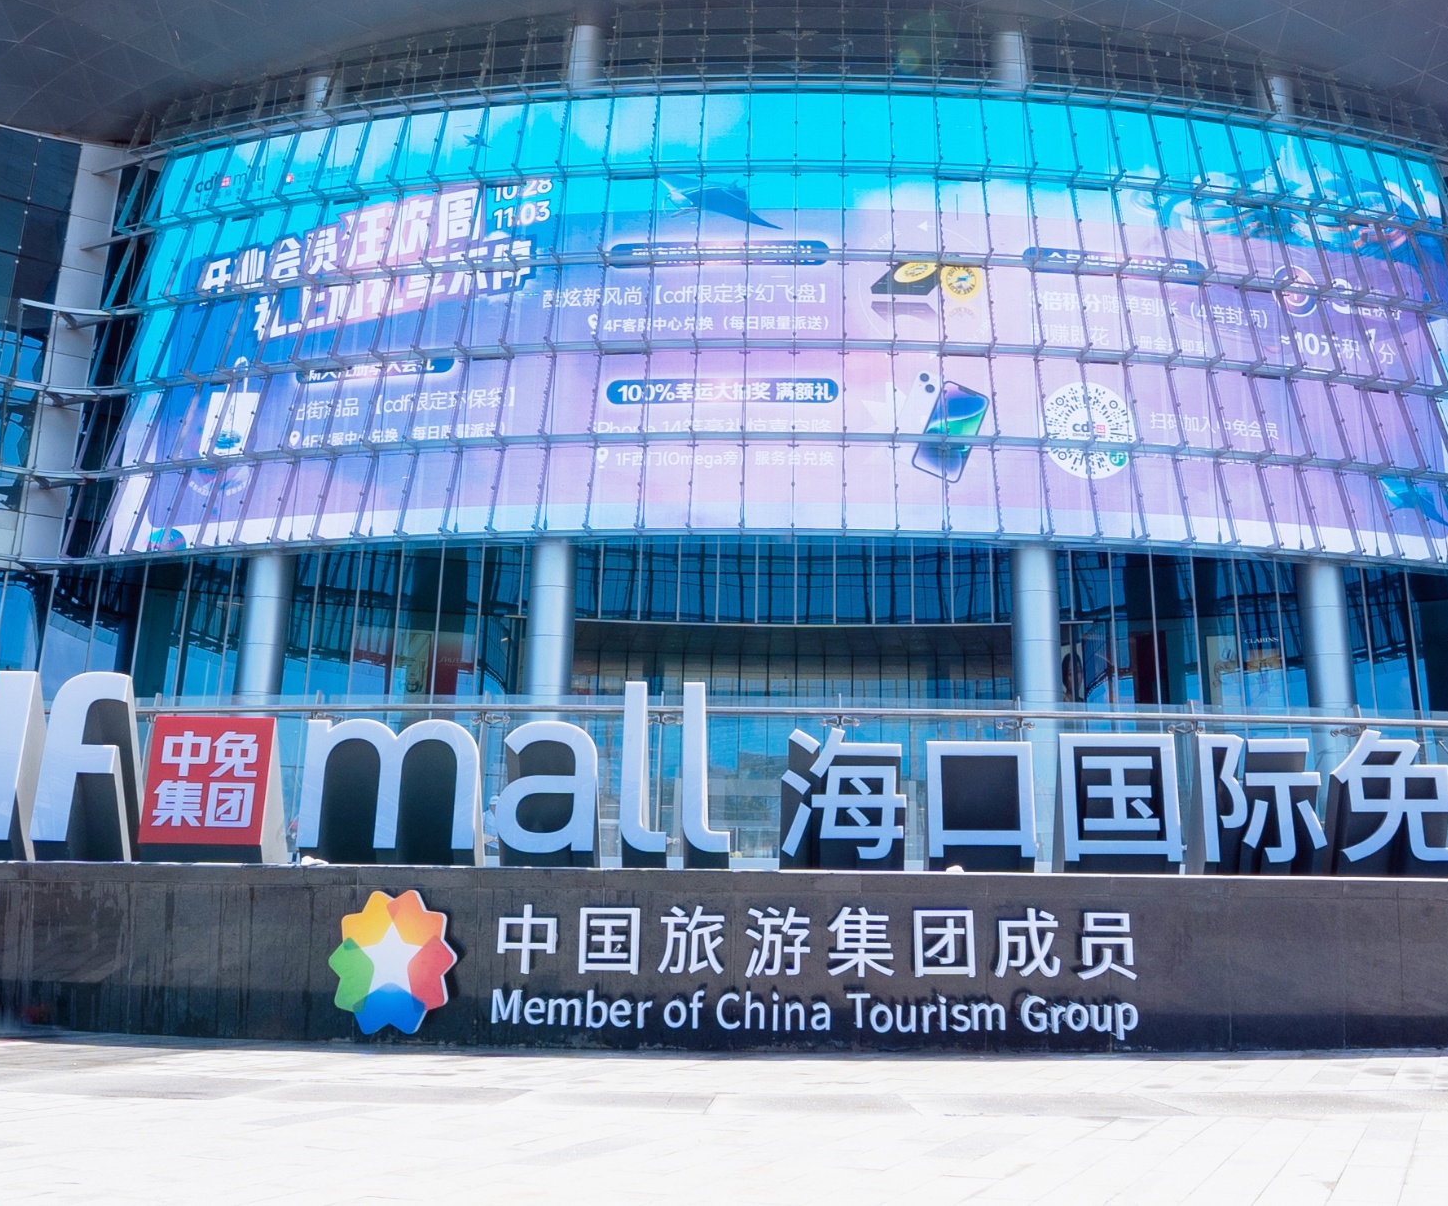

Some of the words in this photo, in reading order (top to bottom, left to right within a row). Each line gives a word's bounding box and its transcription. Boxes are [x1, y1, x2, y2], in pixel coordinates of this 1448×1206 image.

[493, 200, 551, 230] 11.03
[1244, 636, 1279, 644] CLARINS
[160, 730, 259, 779] 中免
[296, 680, 731, 856] mall
[151, 780, 256, 828] 集团
[495, 904, 1138, 981] 中国旅游集团成员
[490, 989, 653, 1029] Member
[663, 990, 705, 1030] of
[716, 990, 832, 1032] China
[845, 993, 1006, 1034] Tourism
[1020, 995, 1138, 1041] Group
